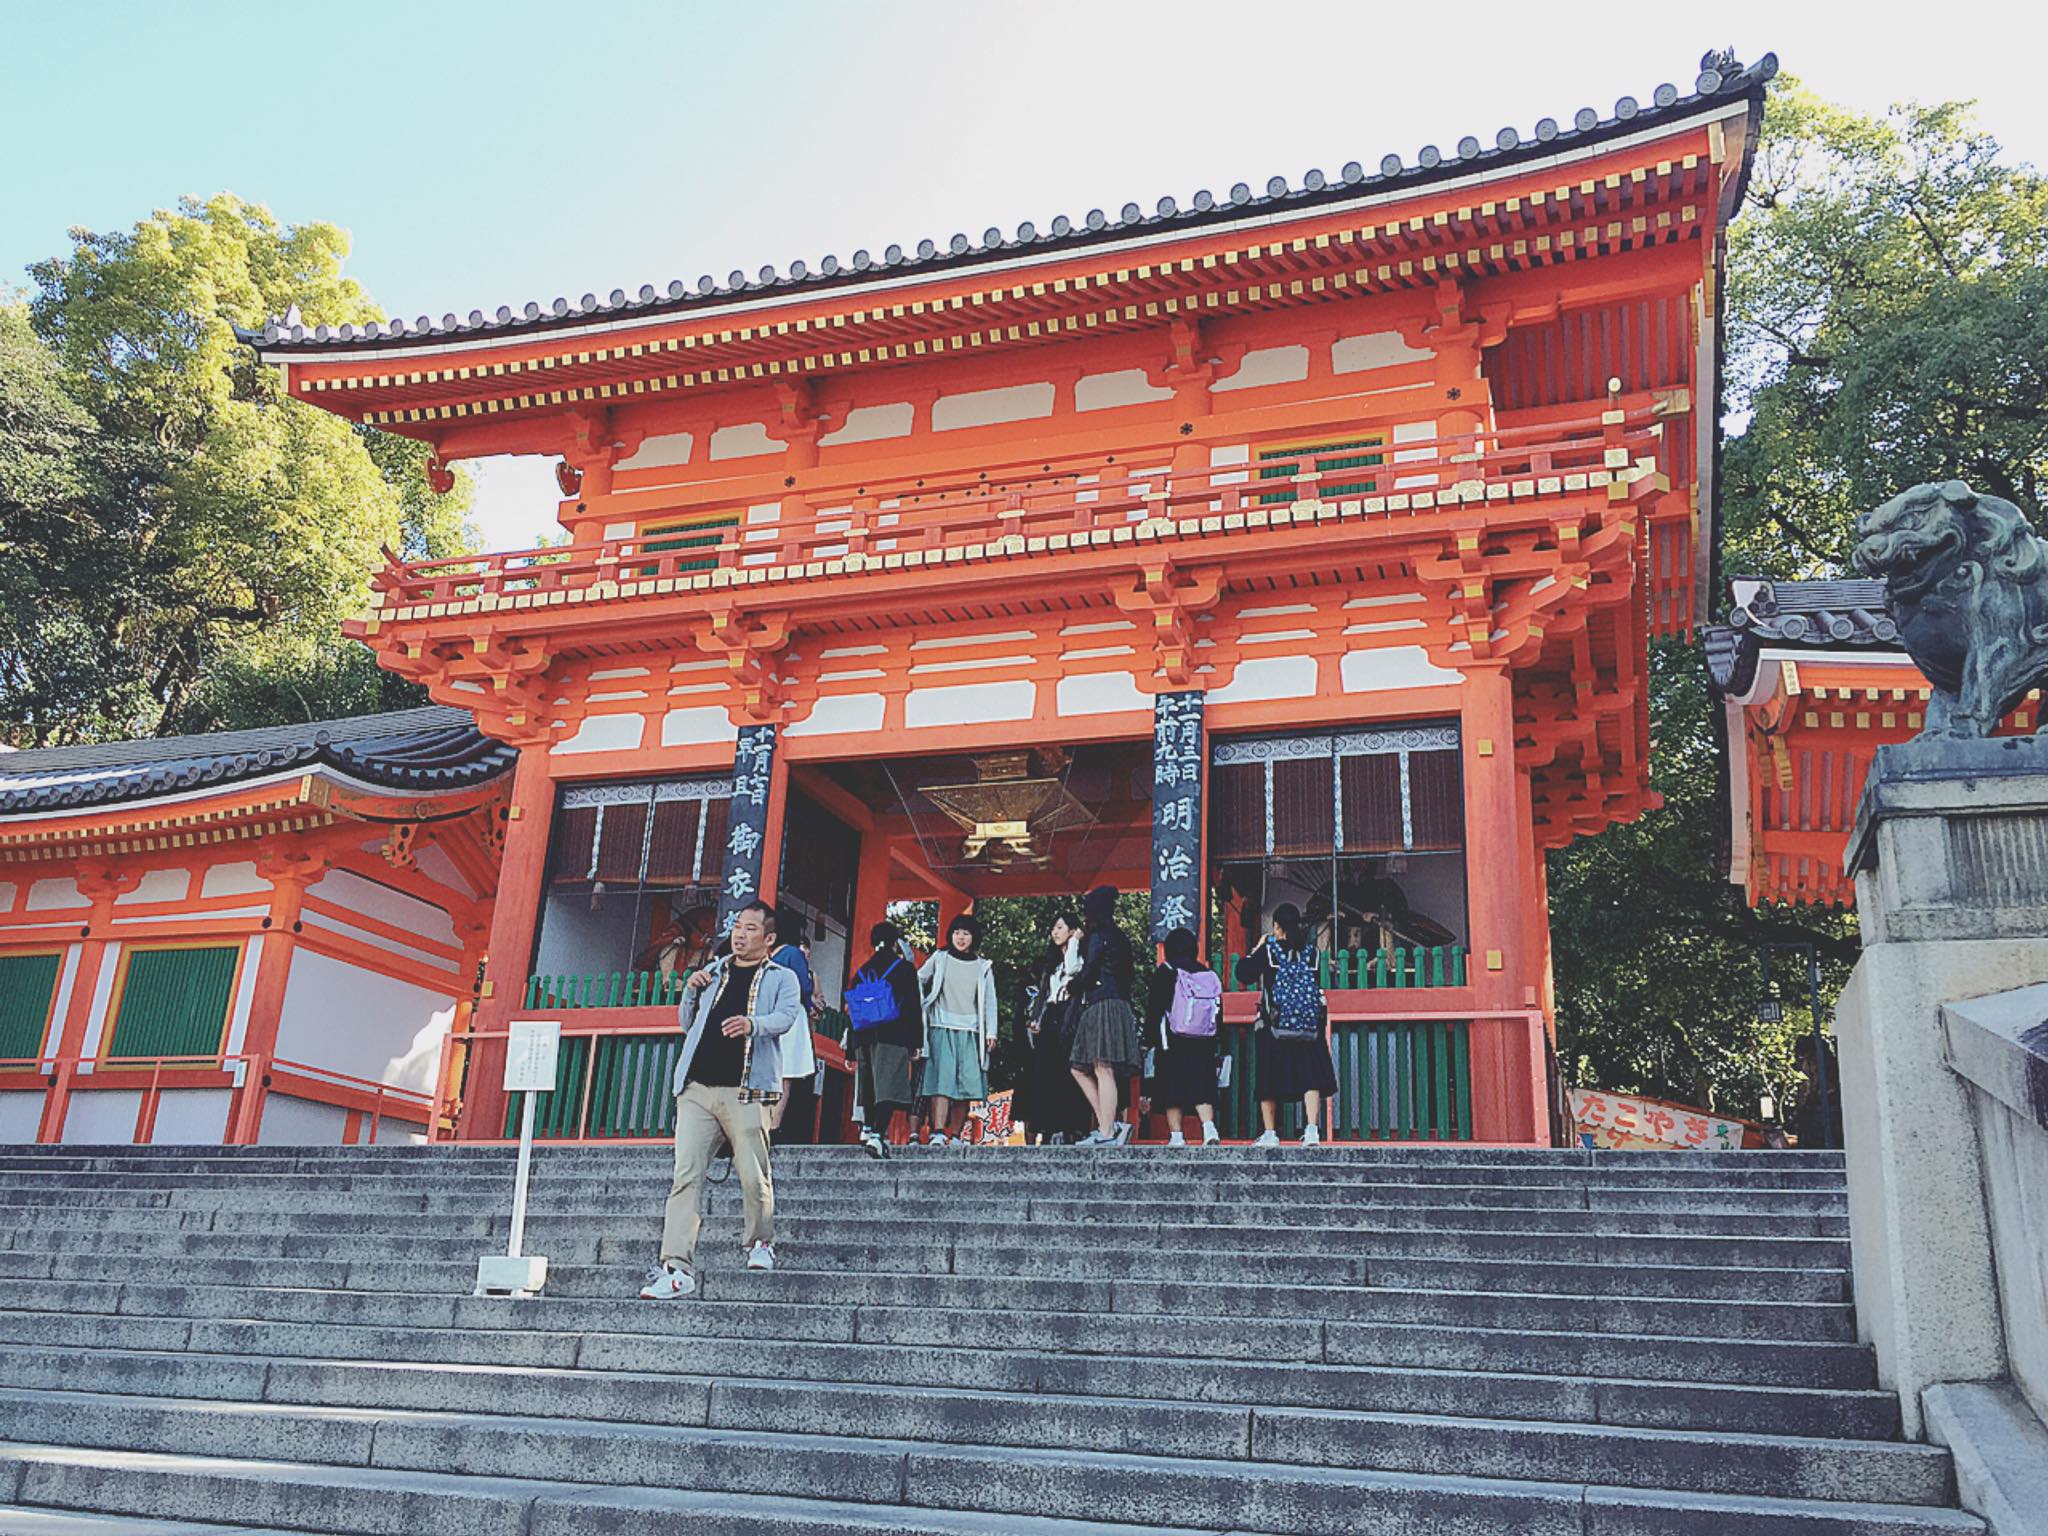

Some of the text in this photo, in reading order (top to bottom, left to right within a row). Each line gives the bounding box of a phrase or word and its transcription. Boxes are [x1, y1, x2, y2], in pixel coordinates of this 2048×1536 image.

[1155, 694, 1180, 789] 午前九時
[1178, 694, 1203, 781] 十一月三日
[1156, 797, 1194, 931] 明治祭
